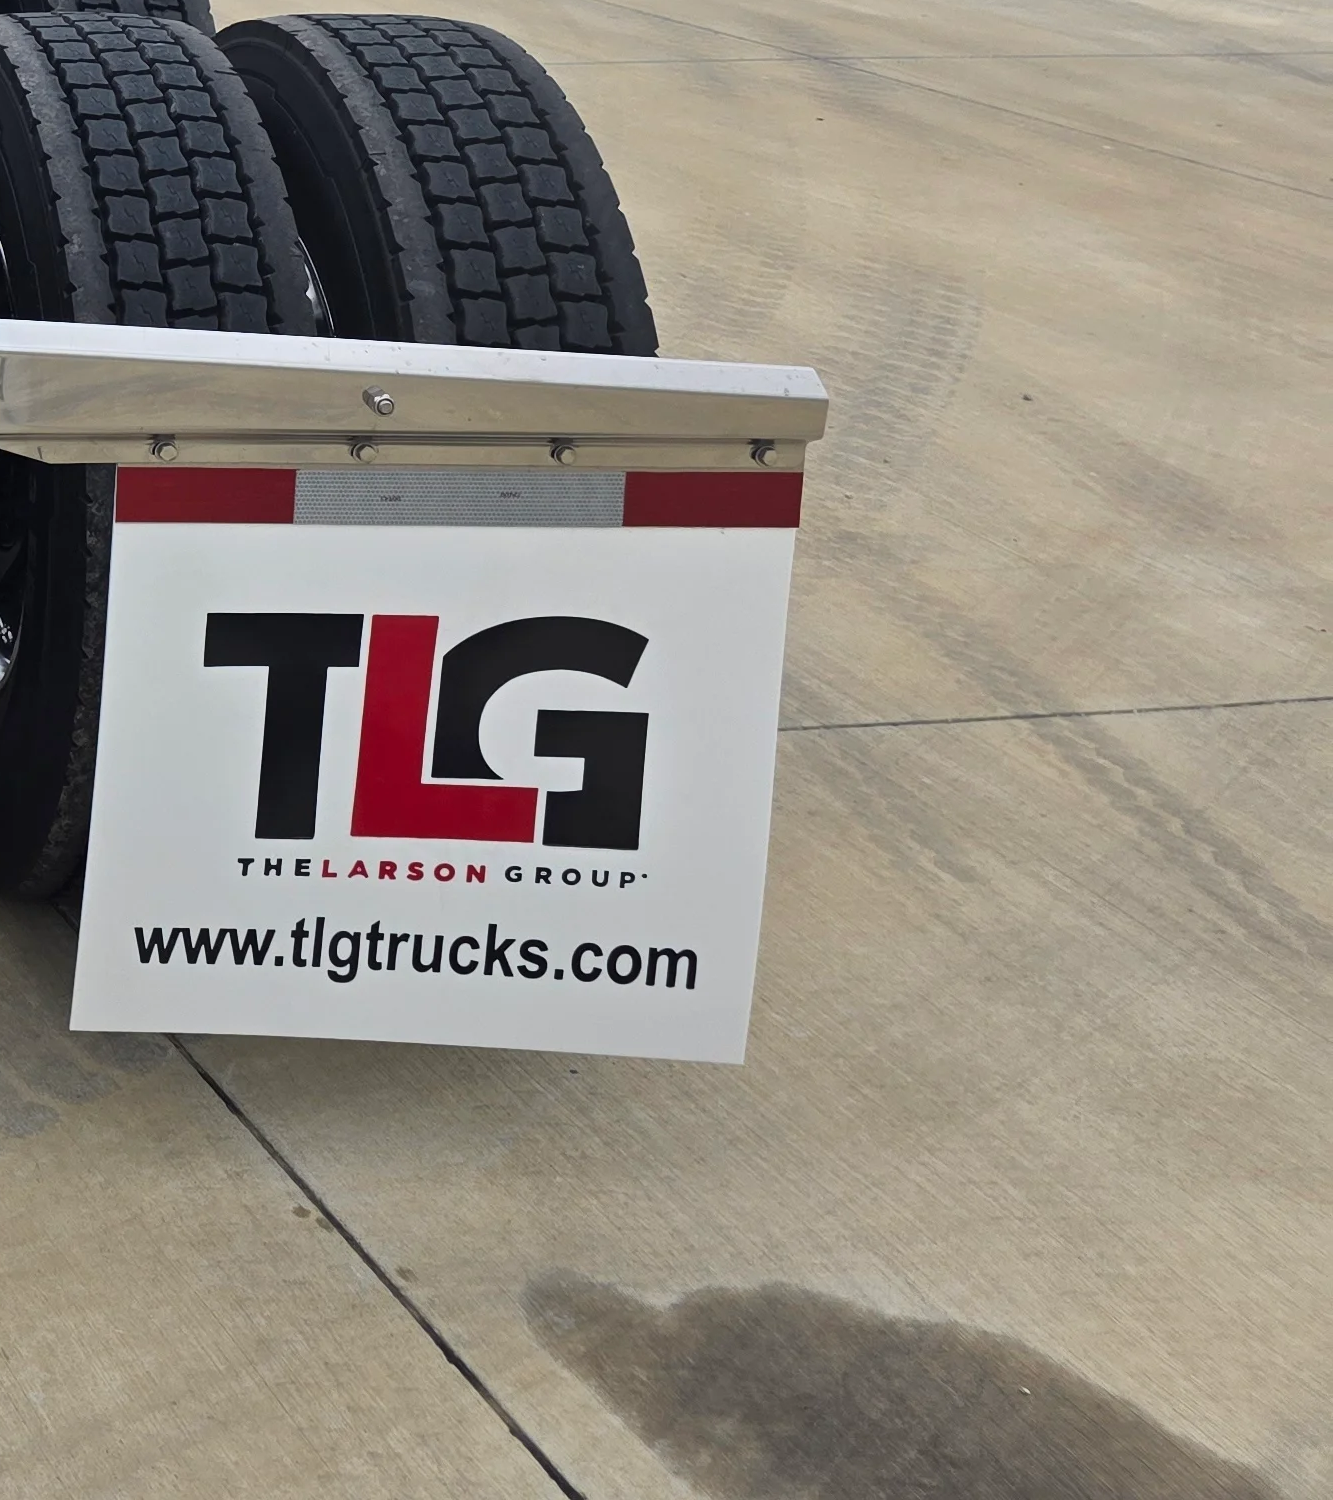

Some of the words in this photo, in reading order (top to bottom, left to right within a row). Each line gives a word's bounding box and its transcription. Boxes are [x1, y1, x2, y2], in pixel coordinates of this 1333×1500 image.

[204, 613, 650, 850] TLG
[505, 866, 637, 889] GROUP
[135, 917, 699, 990] www.tlgtrucks.com
